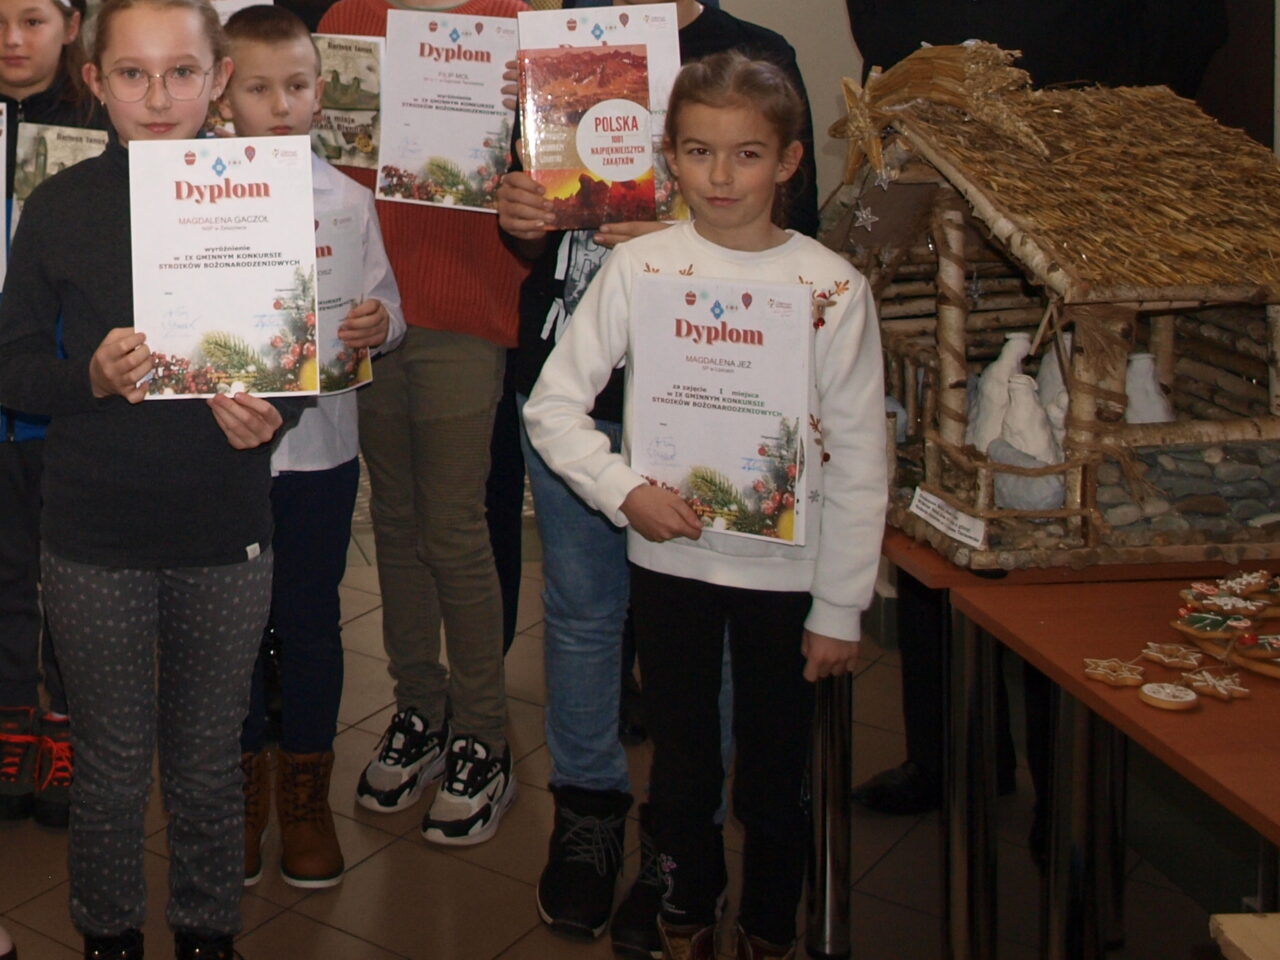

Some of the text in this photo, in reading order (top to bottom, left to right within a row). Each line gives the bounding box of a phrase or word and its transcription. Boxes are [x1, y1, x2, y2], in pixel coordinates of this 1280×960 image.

[419, 42, 491, 63] Dyplom
[594, 116, 639, 133] POLSKA
[174, 178, 271, 204] Dyplom
[179, 216, 232, 225] MAGDALENA
[675, 318, 764, 346] Dyplom
[686, 355, 735, 366] MAGDALENA
[685, 393, 720, 402] GMINNYM
[722, 398, 765, 407] KONKURSIE
